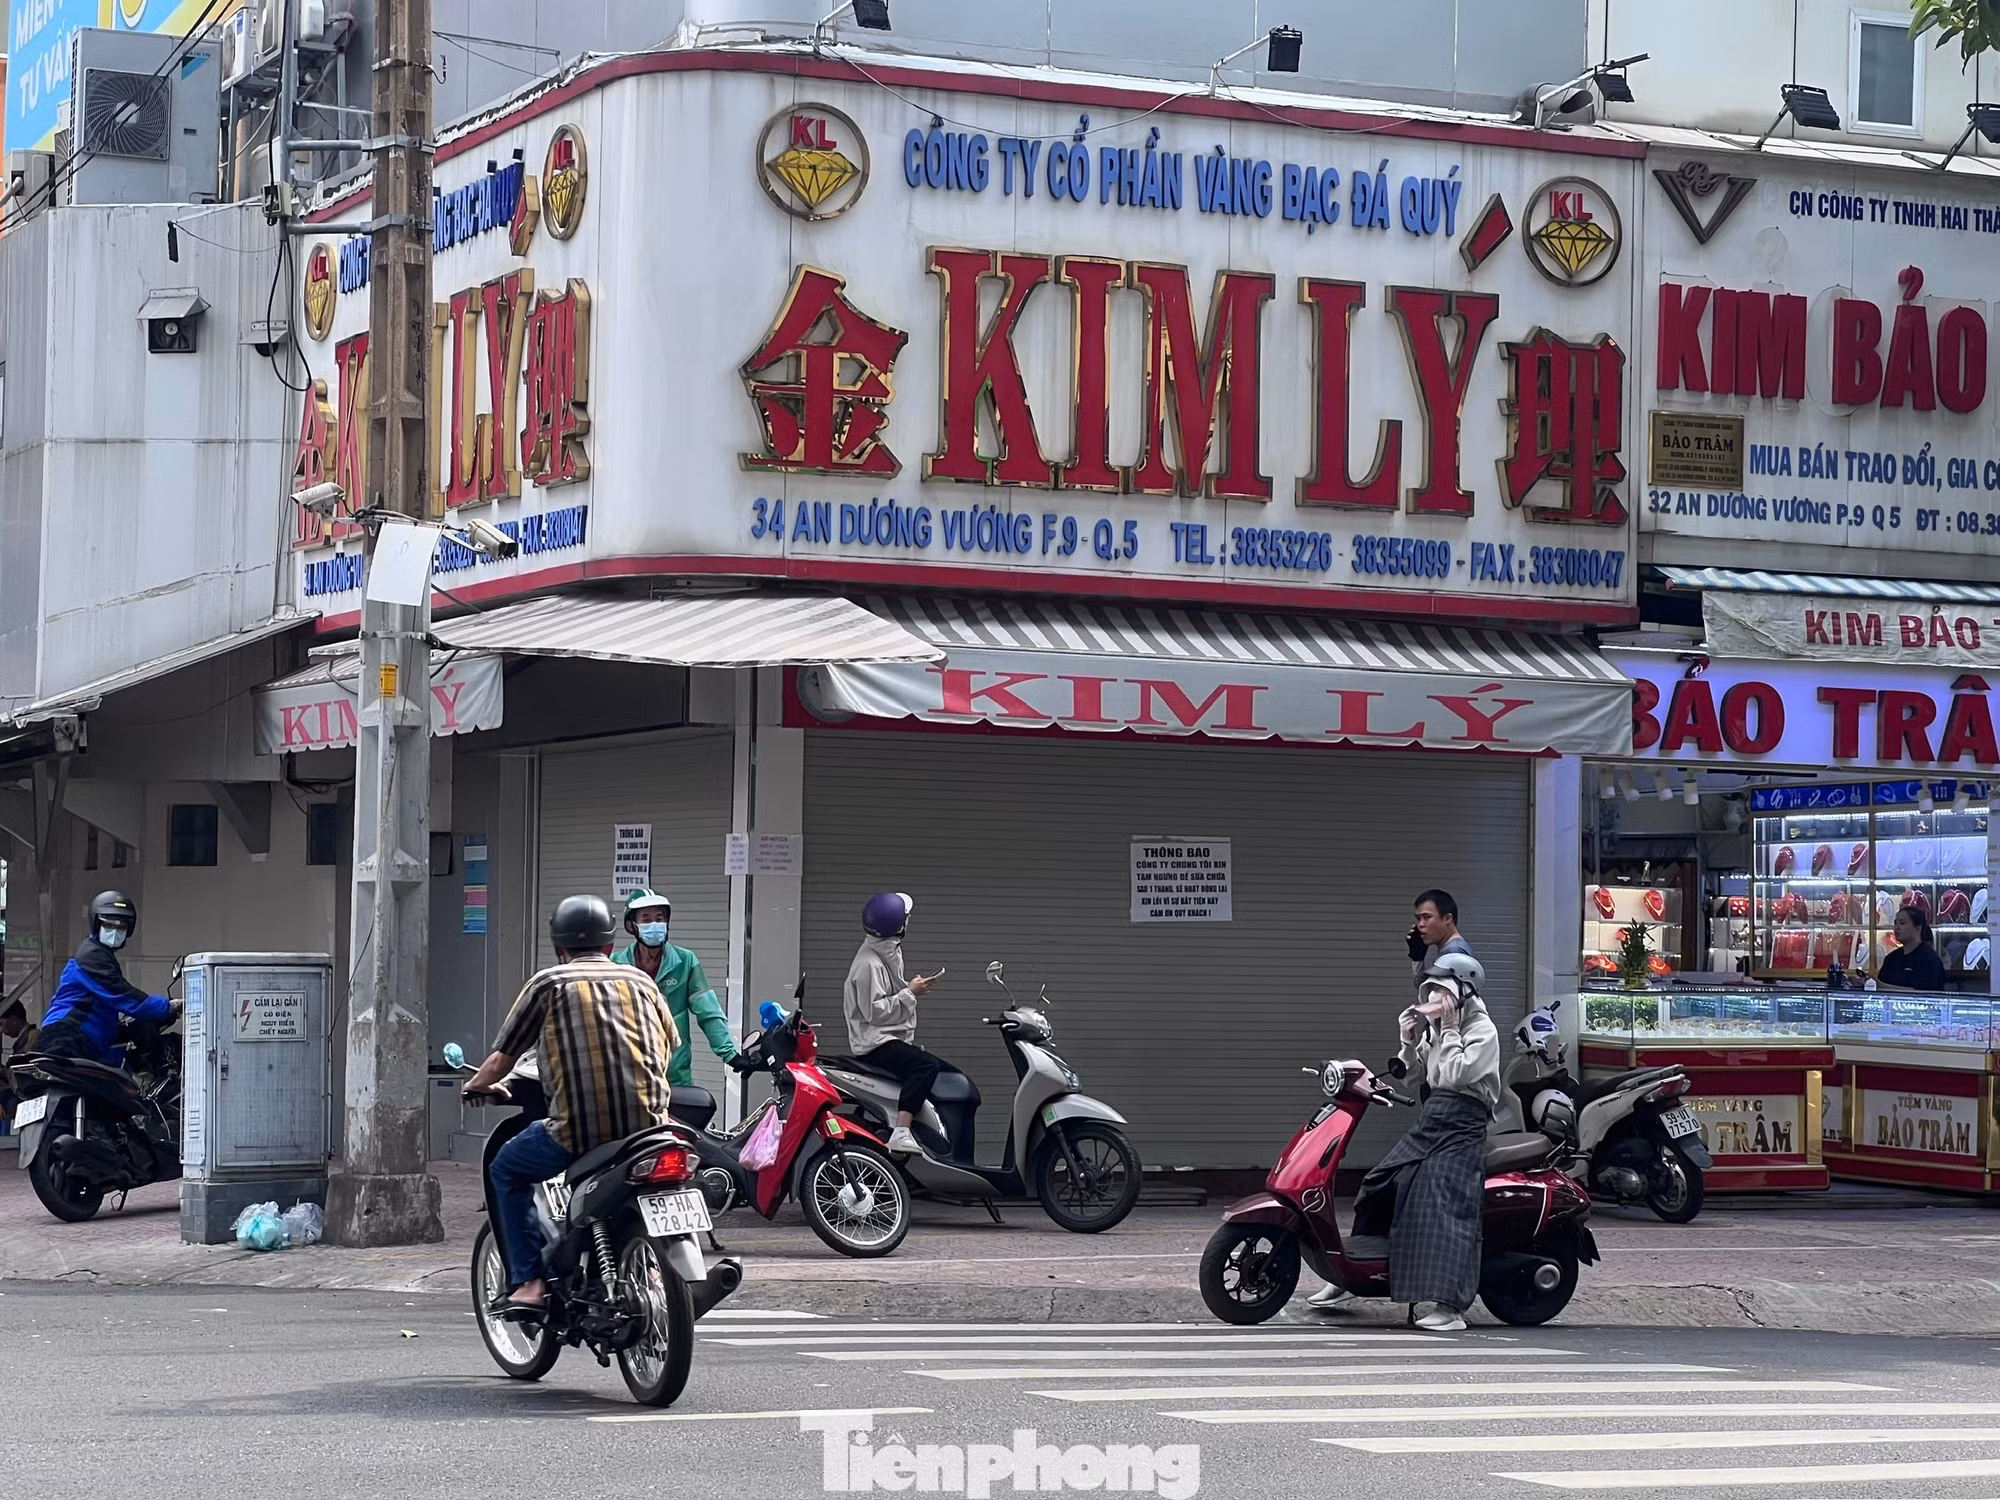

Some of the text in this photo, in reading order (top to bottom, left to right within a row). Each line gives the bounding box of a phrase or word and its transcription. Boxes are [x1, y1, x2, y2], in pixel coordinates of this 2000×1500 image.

[790, 115, 837, 150] KL
[904, 114, 1462, 236] CÔNG TY CỔ PHẦN VÀNG BẠC ĐÁ QUÝ
[1550, 190, 1594, 221] KL
[1789, 190, 1813, 217] CN
[1818, 190, 1864, 221] CÔNG
[1869, 198, 1889, 223] TY
[1893, 201, 1936, 228] TNHH
[1941, 206, 1968, 231] HAI
[920, 193, 1514, 517] KIM LÝ
[1657, 265, 1988, 413] KIM BẢO
[737, 263, 909, 480] 金
[1662, 430, 1734, 452] BẢO TRÂM
[1750, 444, 1792, 477] MUA
[1799, 442, 1839, 480] BÁN
[1846, 451, 1896, 484] TRAO
[1947, 457, 1978, 490] GIA
[751, 497, 785, 541] 34
[792, 500, 832, 542] AN
[840, 497, 932, 549] DƯƠNG
[941, 504, 1032, 554] VƯƠNG
[1648, 490, 1671, 514] 32
[1675, 493, 1701, 516] AN
[1706, 491, 1767, 521] DƯƠNG
[1772, 496, 1831, 525] VƯƠNG
[1836, 503, 1864, 527] P.9
[1872, 505, 1884, 531] Q
[1889, 506, 1901, 529] 5
[1916, 509, 1940, 532] ĐT
[1957, 511, 2000, 536] 08.3
[1231, 526, 1332, 571] 38353226
[1351, 533, 1451, 579] 38355099
[1529, 545, 1626, 590] 38308047
[1805, 609, 1883, 647] KIM
[1899, 605, 1981, 650] BẢO
[431, 668, 466, 729] Ý
[926, 667, 1534, 744] KIM LÝ
[1817, 674, 2000, 765] TRÂ
[1136, 860, 1158, 869] CÔNG
[1160, 861, 1169, 869] TY
[1213, 861, 1227, 869] XIN
[1143, 846, 1183, 858] THÔNG
[1141, 897, 1152, 905] XIN
[1723, 1097, 1763, 1112] VÀNG
[1924, 1096, 1953, 1112] VÀNG
[1716, 1114, 1792, 1153] TRÂM
[1877, 1104, 1971, 1153] BẢO TRÂM
[649, 1195, 695, 1215] 59-HA
[651, 1212, 705, 1234] 128.42
